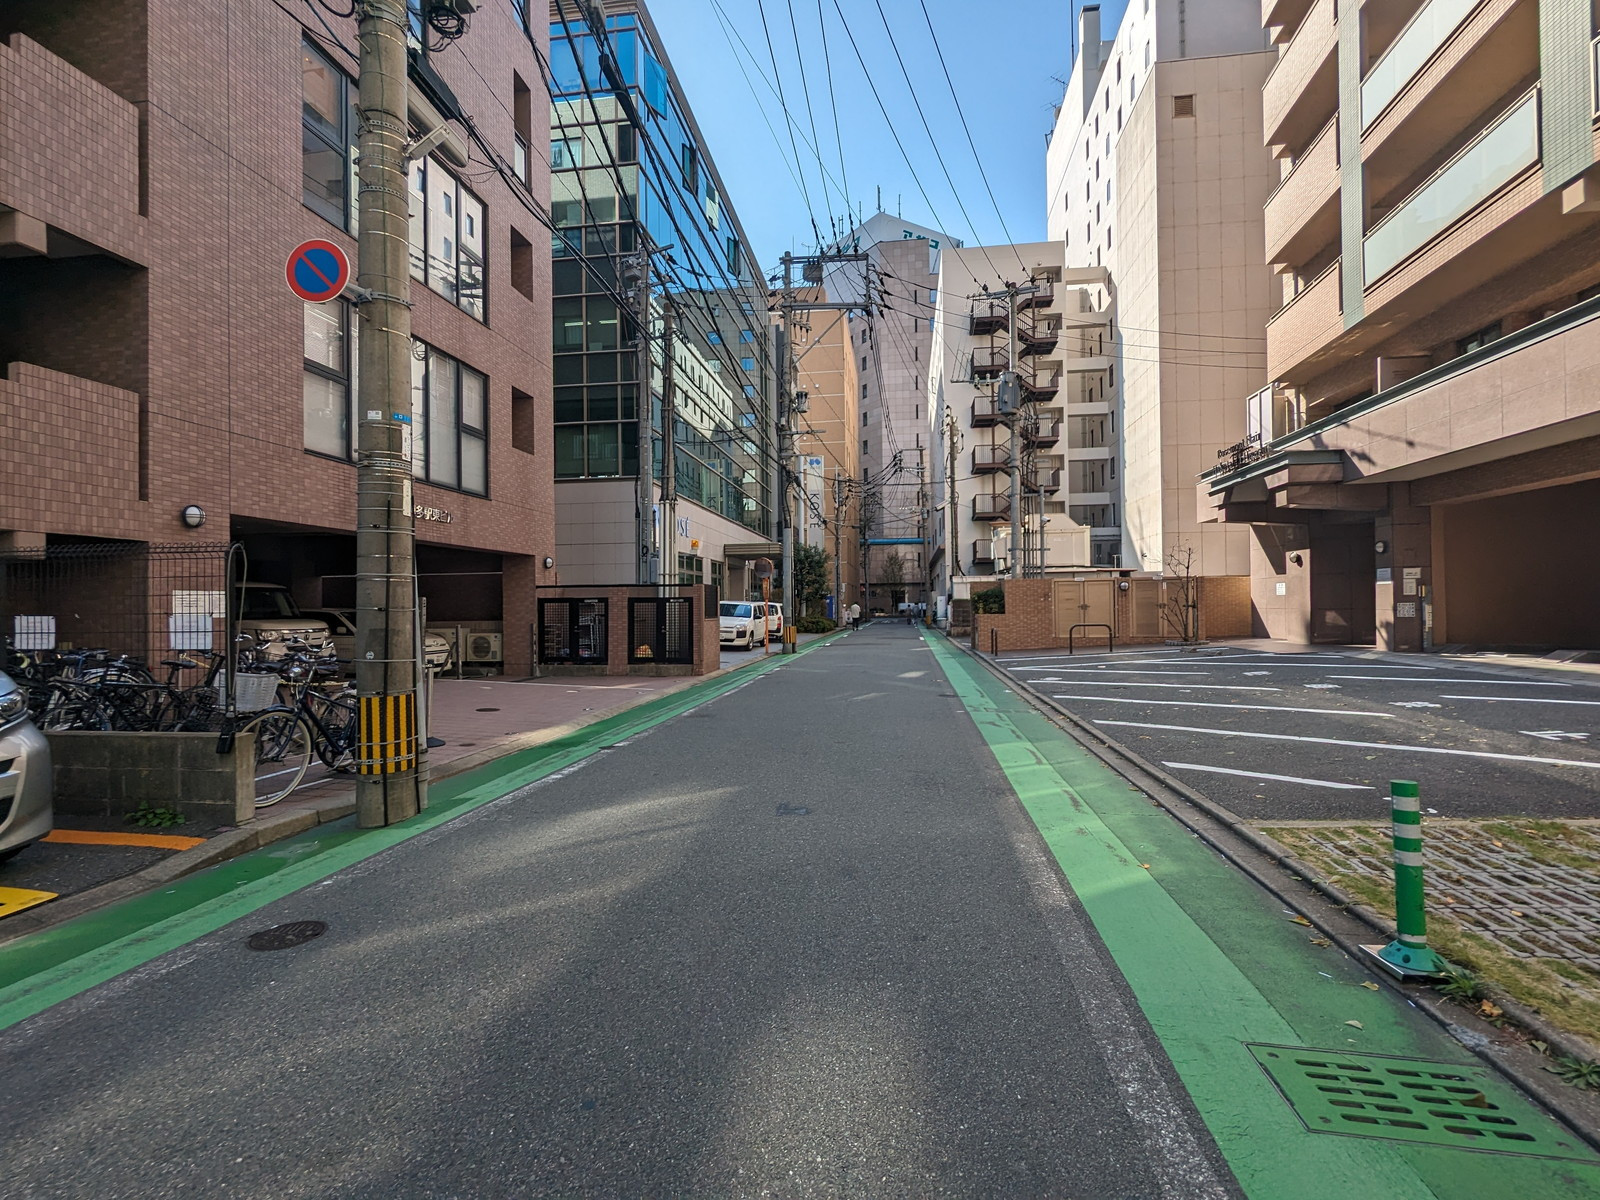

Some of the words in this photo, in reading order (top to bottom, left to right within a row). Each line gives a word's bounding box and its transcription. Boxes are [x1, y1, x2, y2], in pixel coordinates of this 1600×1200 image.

[903, 230, 940, 250] アコ
[414, 505, 454, 523] 多駅東ビル
